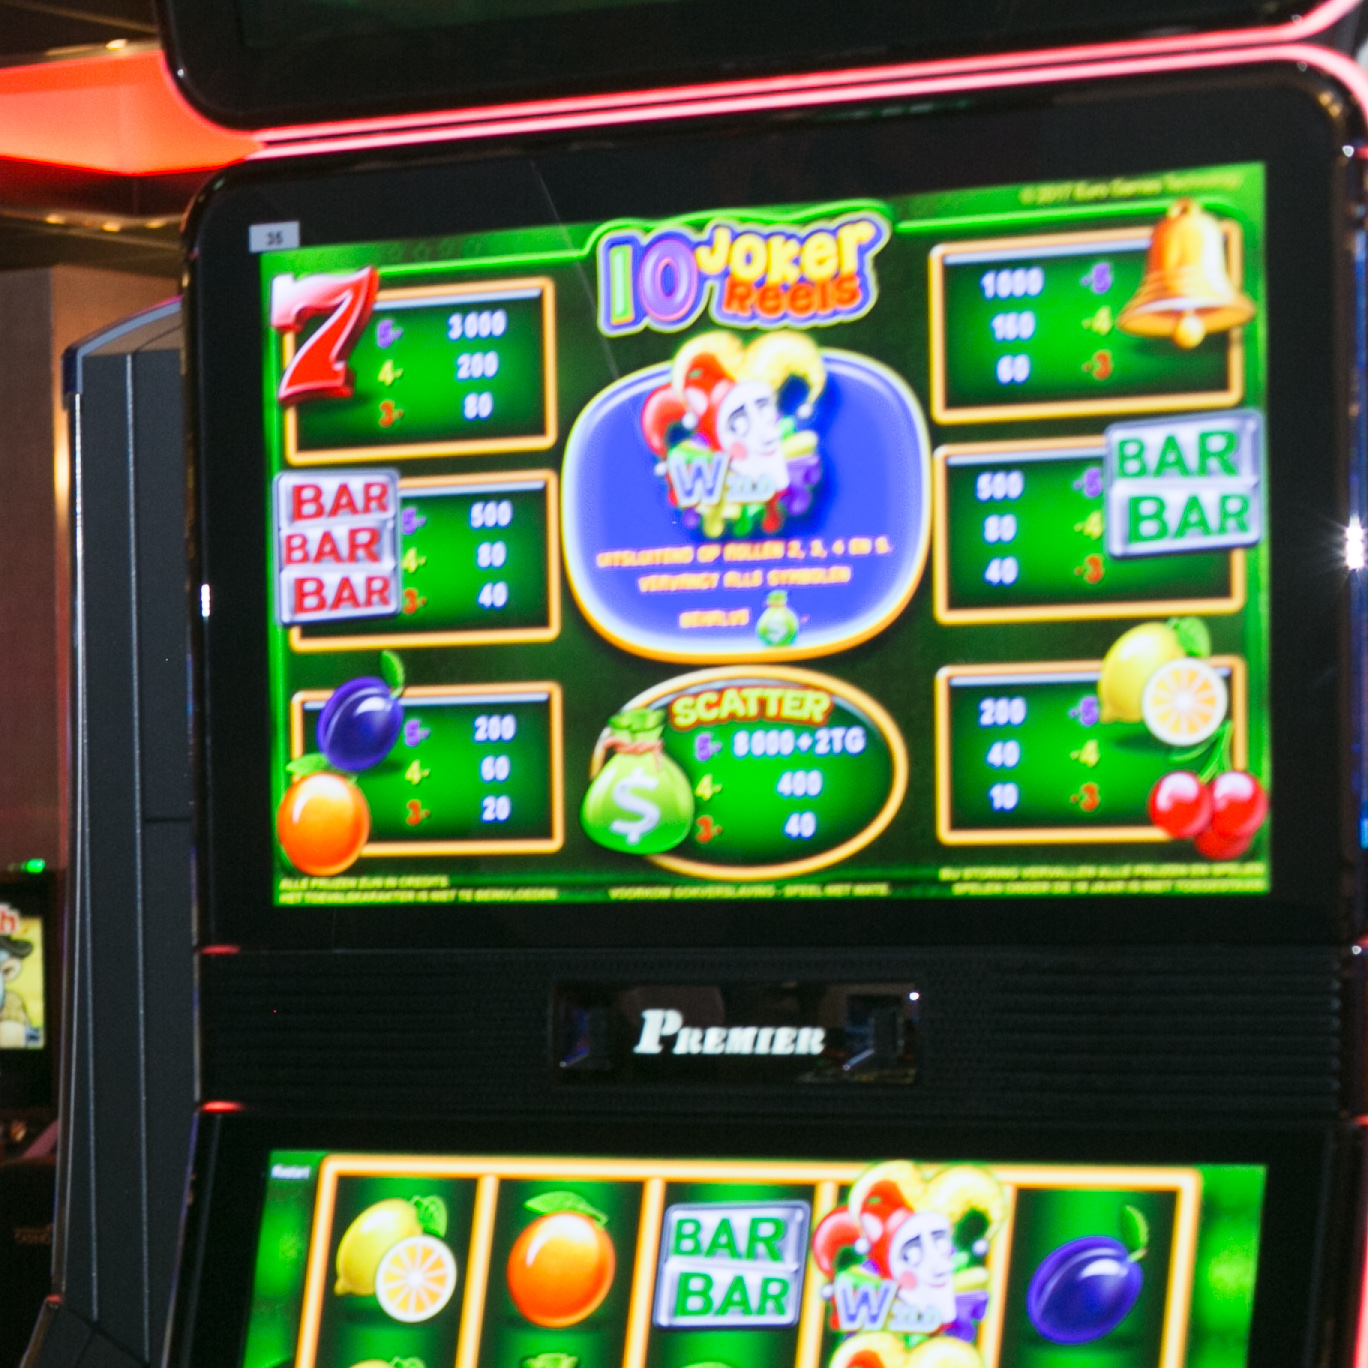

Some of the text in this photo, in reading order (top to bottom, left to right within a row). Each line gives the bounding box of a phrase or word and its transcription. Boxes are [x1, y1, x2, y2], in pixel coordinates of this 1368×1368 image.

[448, 309, 507, 340] 3000
[457, 352, 499, 381] 200
[464, 392, 493, 420] 80
[1118, 431, 1237, 478] BAR
[292, 482, 388, 522] BAR
[469, 500, 513, 529] 500
[1128, 494, 1251, 543] BAR
[284, 527, 380, 565] BAR
[294, 576, 391, 615] BAR
[477, 581, 509, 609] 40
[671, 687, 832, 727] SCATTER
[474, 715, 516, 743] 200
[777, 770, 823, 798] 400
[481, 795, 511, 822] 20
[784, 812, 816, 839] 40
[633, 1008, 826, 1055] PREMIER
[673, 1216, 786, 1261] BAR
[676, 1271, 792, 1316] BAR
